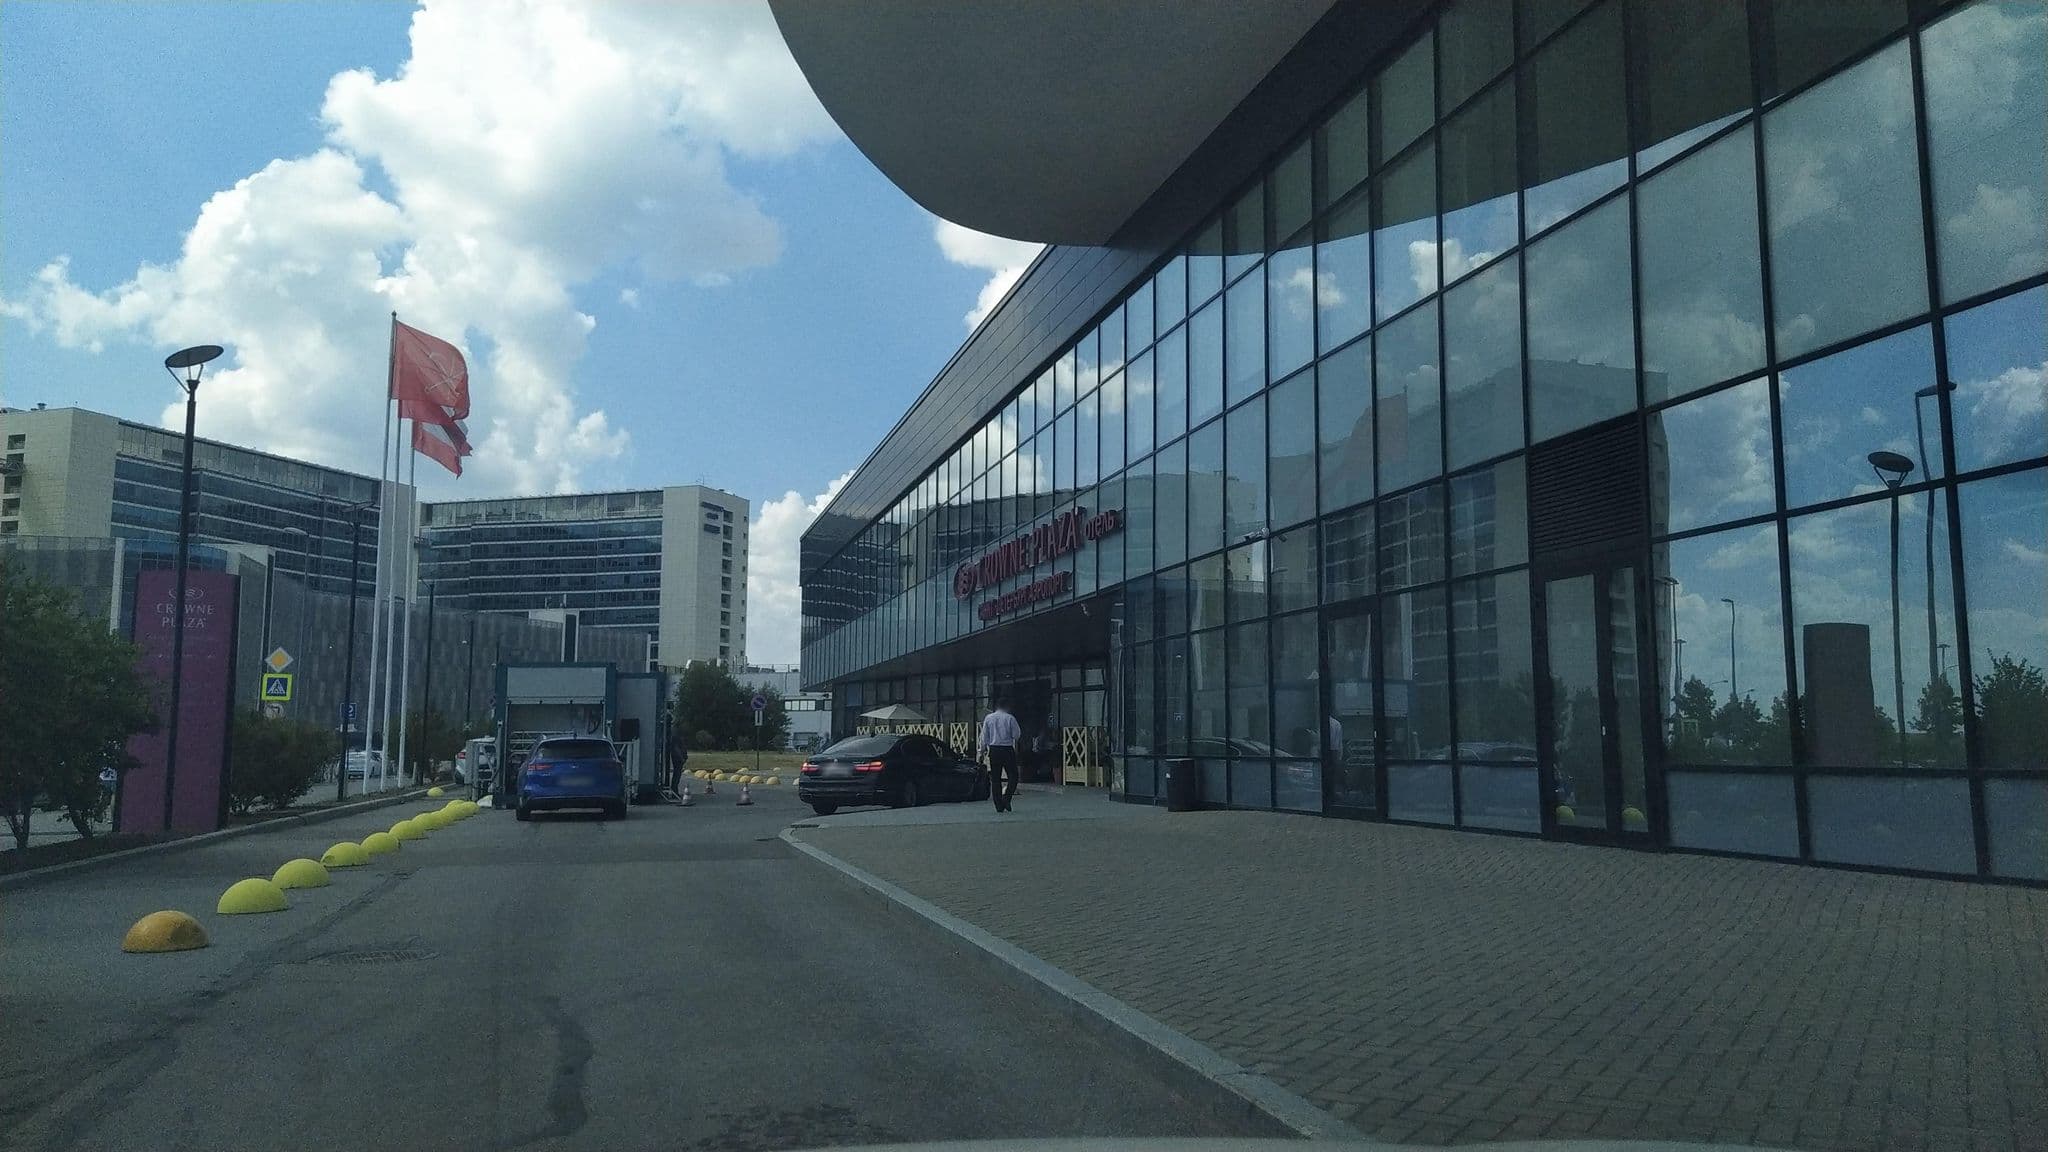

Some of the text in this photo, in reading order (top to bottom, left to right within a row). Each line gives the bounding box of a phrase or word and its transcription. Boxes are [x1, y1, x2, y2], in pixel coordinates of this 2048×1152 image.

[1031, 510, 1080, 563] PLAZA
[156, 603, 215, 615] CRWNE
[161, 616, 205, 628] PLZA
